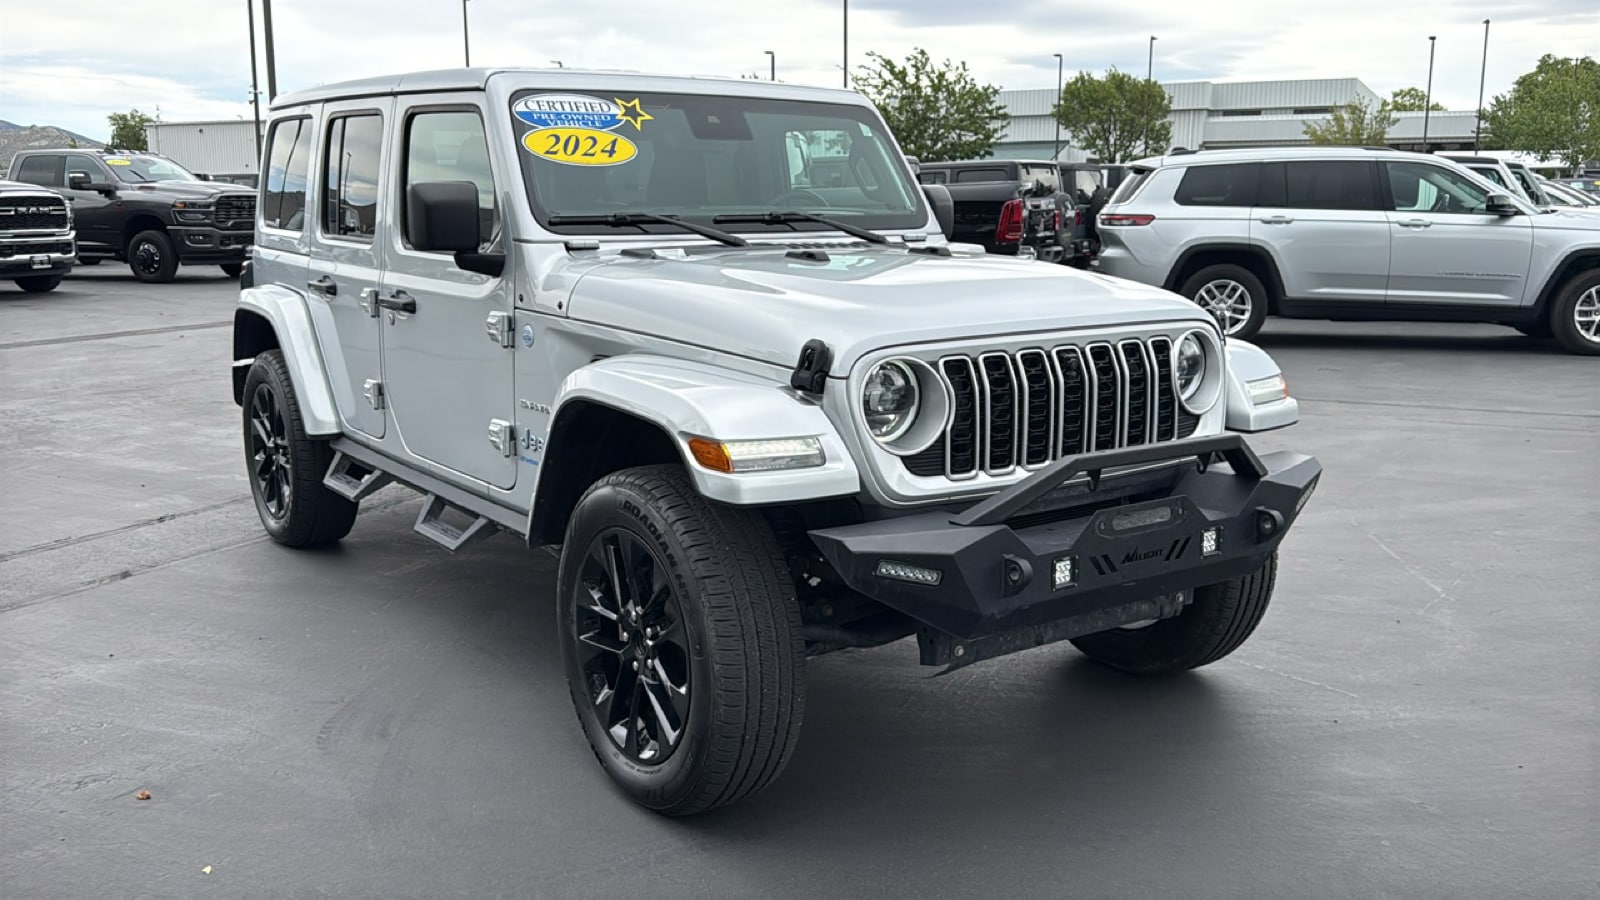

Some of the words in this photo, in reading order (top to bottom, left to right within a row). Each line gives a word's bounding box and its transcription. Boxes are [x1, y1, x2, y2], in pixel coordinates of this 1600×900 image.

[524, 99, 612, 113] CERTIFIED
[532, 112, 611, 122] PRE-OWNED
[546, 119, 603, 128] VEHICLE
[543, 133, 619, 159] 2024
